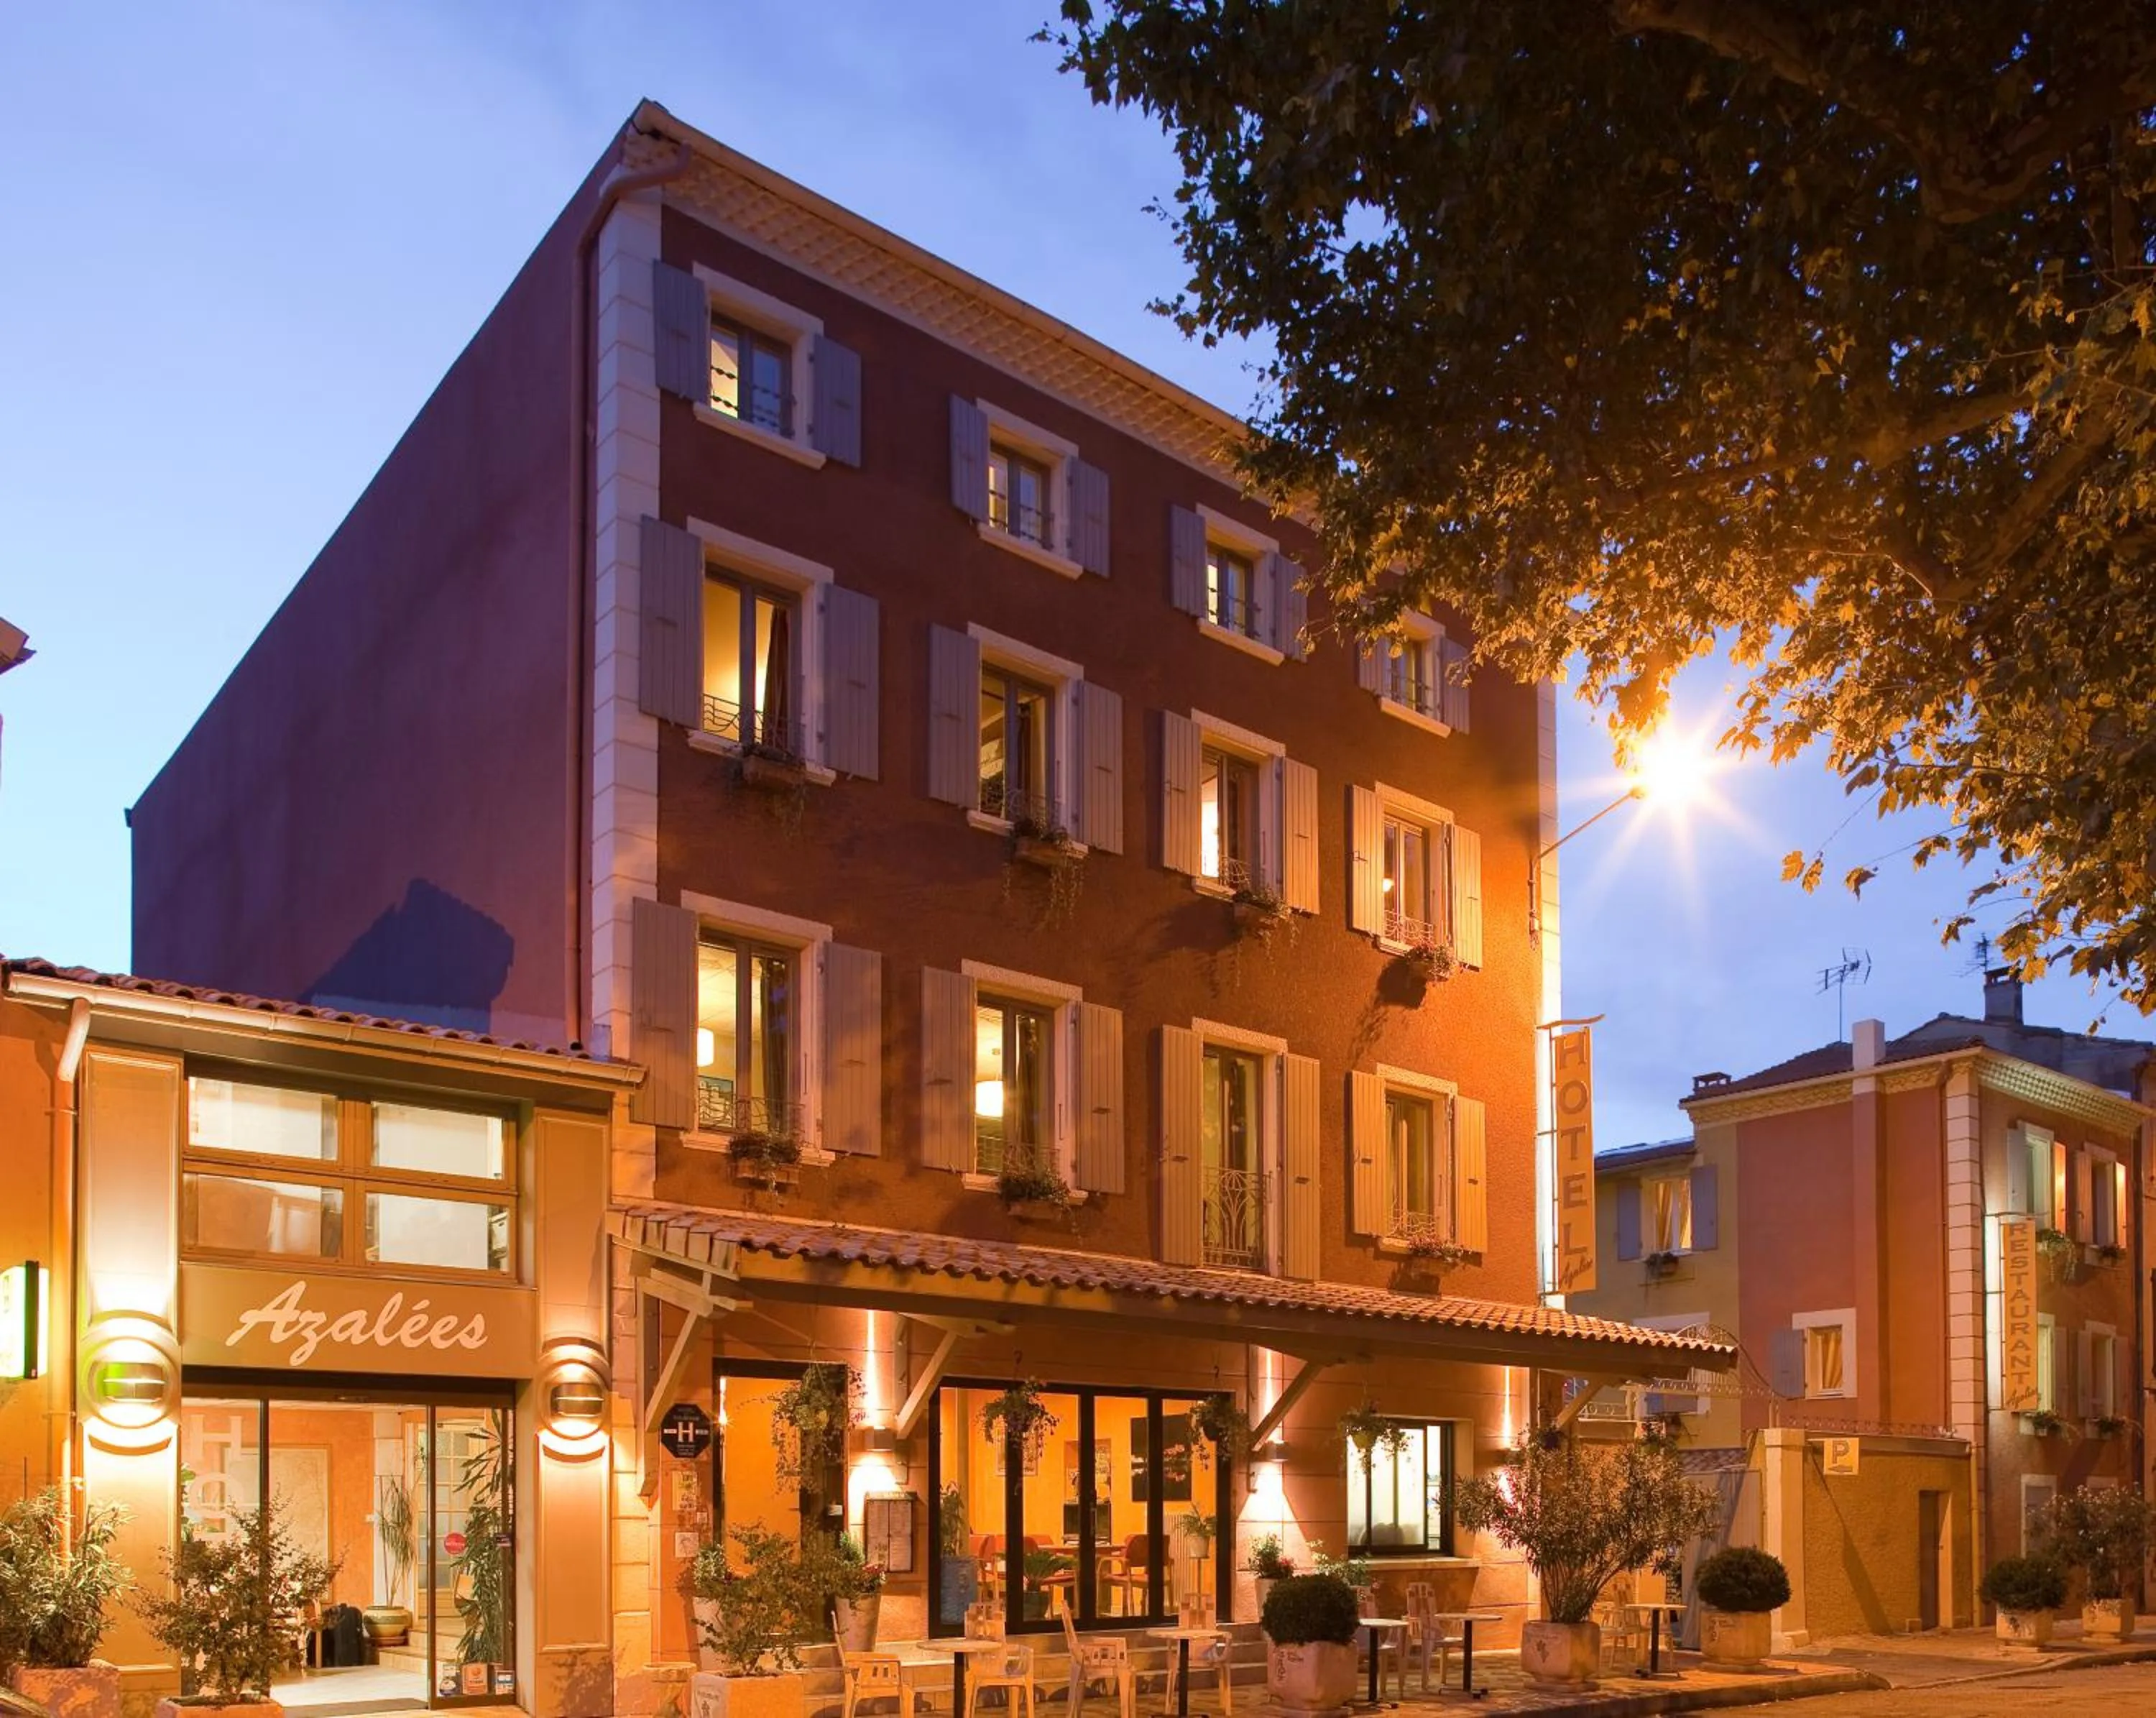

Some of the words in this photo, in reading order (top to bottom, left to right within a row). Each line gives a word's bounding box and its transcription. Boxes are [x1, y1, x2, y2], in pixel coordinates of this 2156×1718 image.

[1559, 1032, 1588, 1255] HOTEL
[226, 1280, 488, 1366] Azalées
[2009, 1223, 2031, 1384] RESTAURANT
[678, 1421, 694, 1443] H
[1832, 1440, 1850, 1464] P
